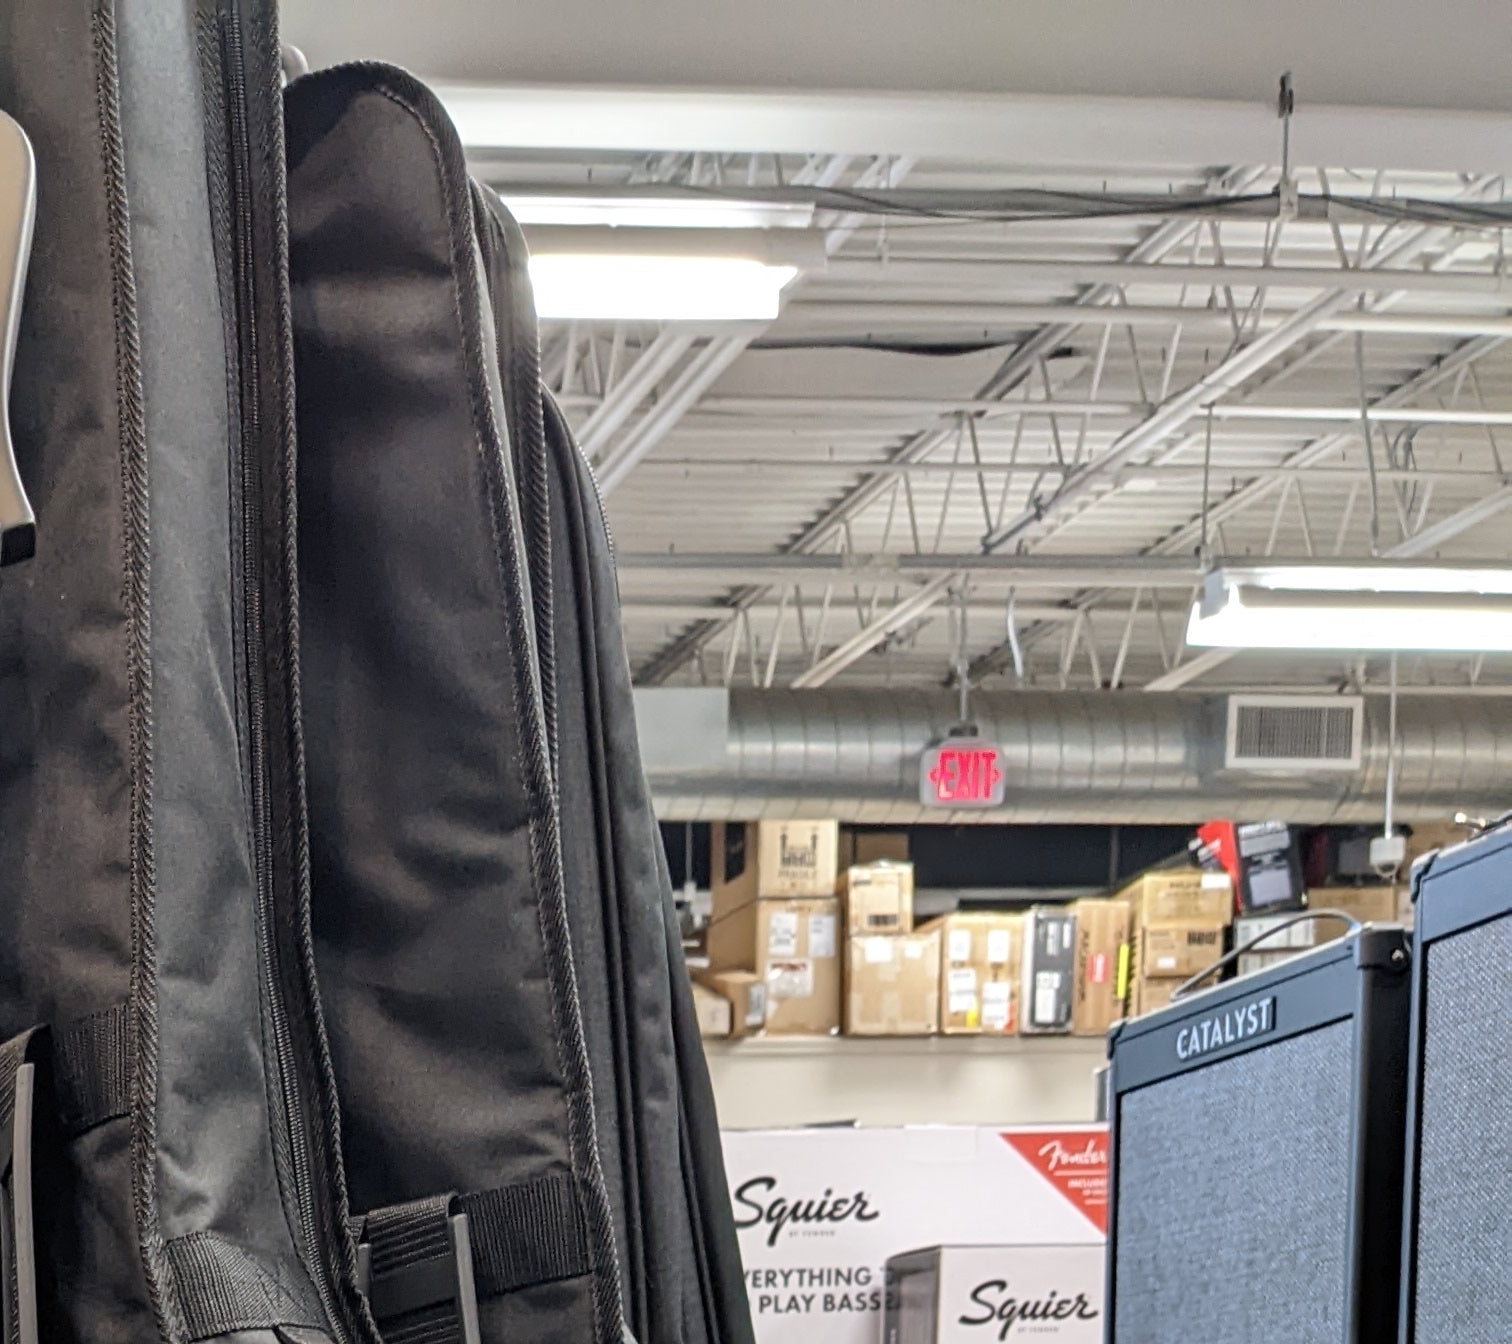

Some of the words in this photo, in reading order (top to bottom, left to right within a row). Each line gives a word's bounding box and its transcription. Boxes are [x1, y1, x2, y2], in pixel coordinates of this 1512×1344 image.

[939, 751, 996, 801] EXIT
[1176, 997, 1272, 1060] CATALYST
[734, 1176, 880, 1247] Squier
[744, 1267, 872, 1288] ERYTHING
[759, 1294, 816, 1314] PLAY
[823, 1292, 881, 1312] BASS
[958, 1280, 1098, 1342] Squier
